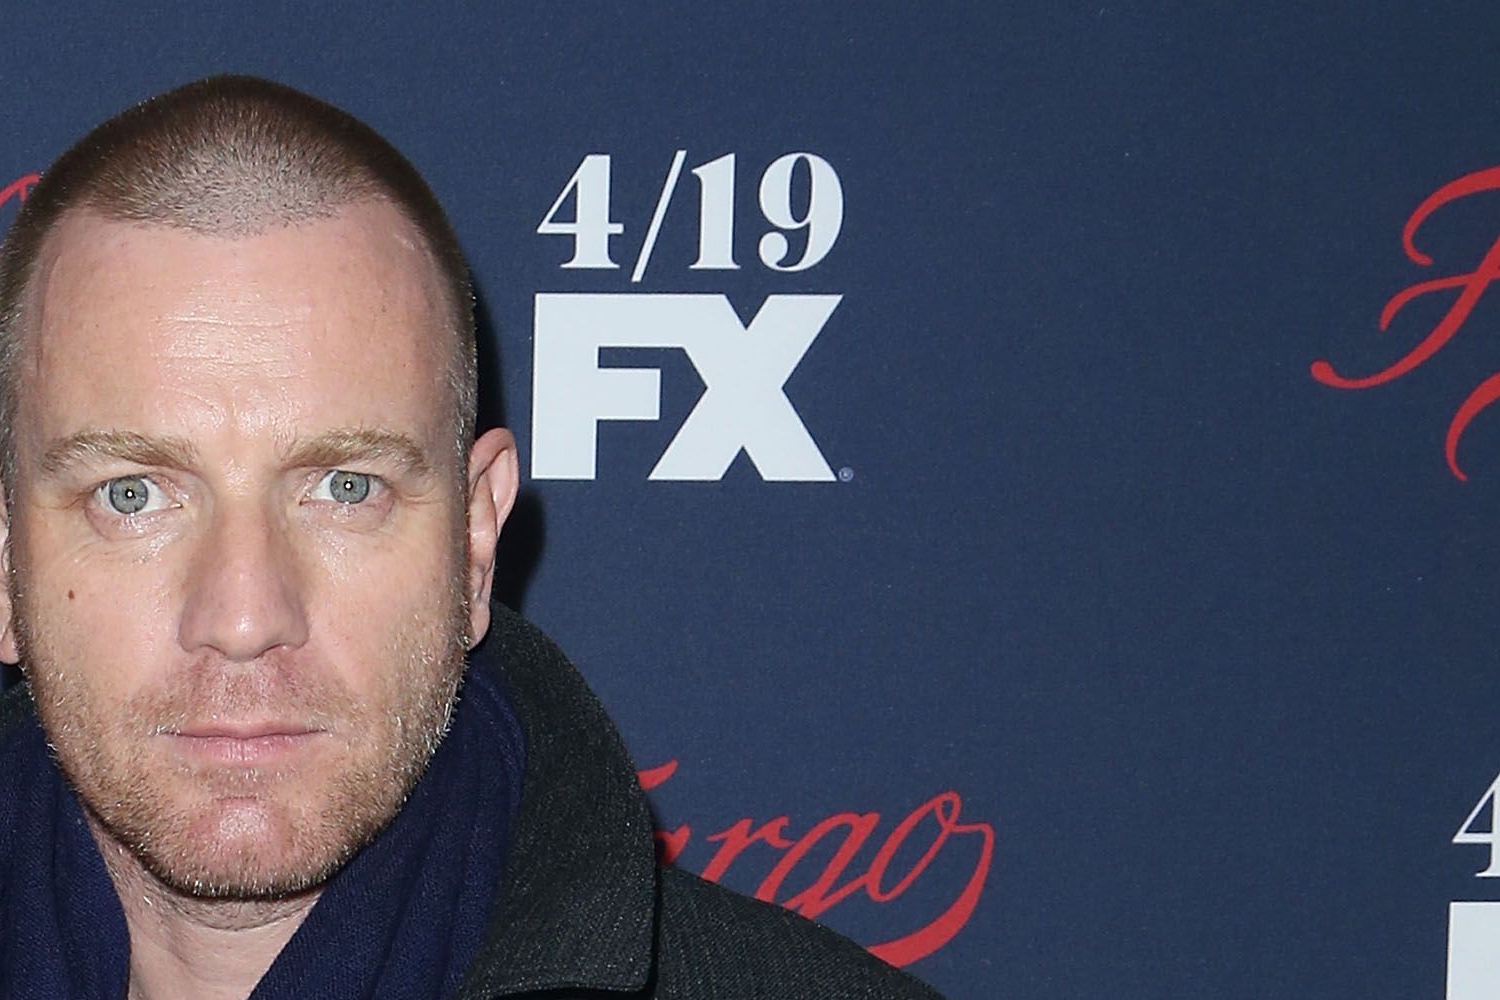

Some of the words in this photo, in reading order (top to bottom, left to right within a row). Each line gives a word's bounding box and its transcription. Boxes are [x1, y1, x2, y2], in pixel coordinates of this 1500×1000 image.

[536, 150, 844, 283] 4/19
[531, 293, 844, 482] FX
[637, 759, 995, 968] rgo
